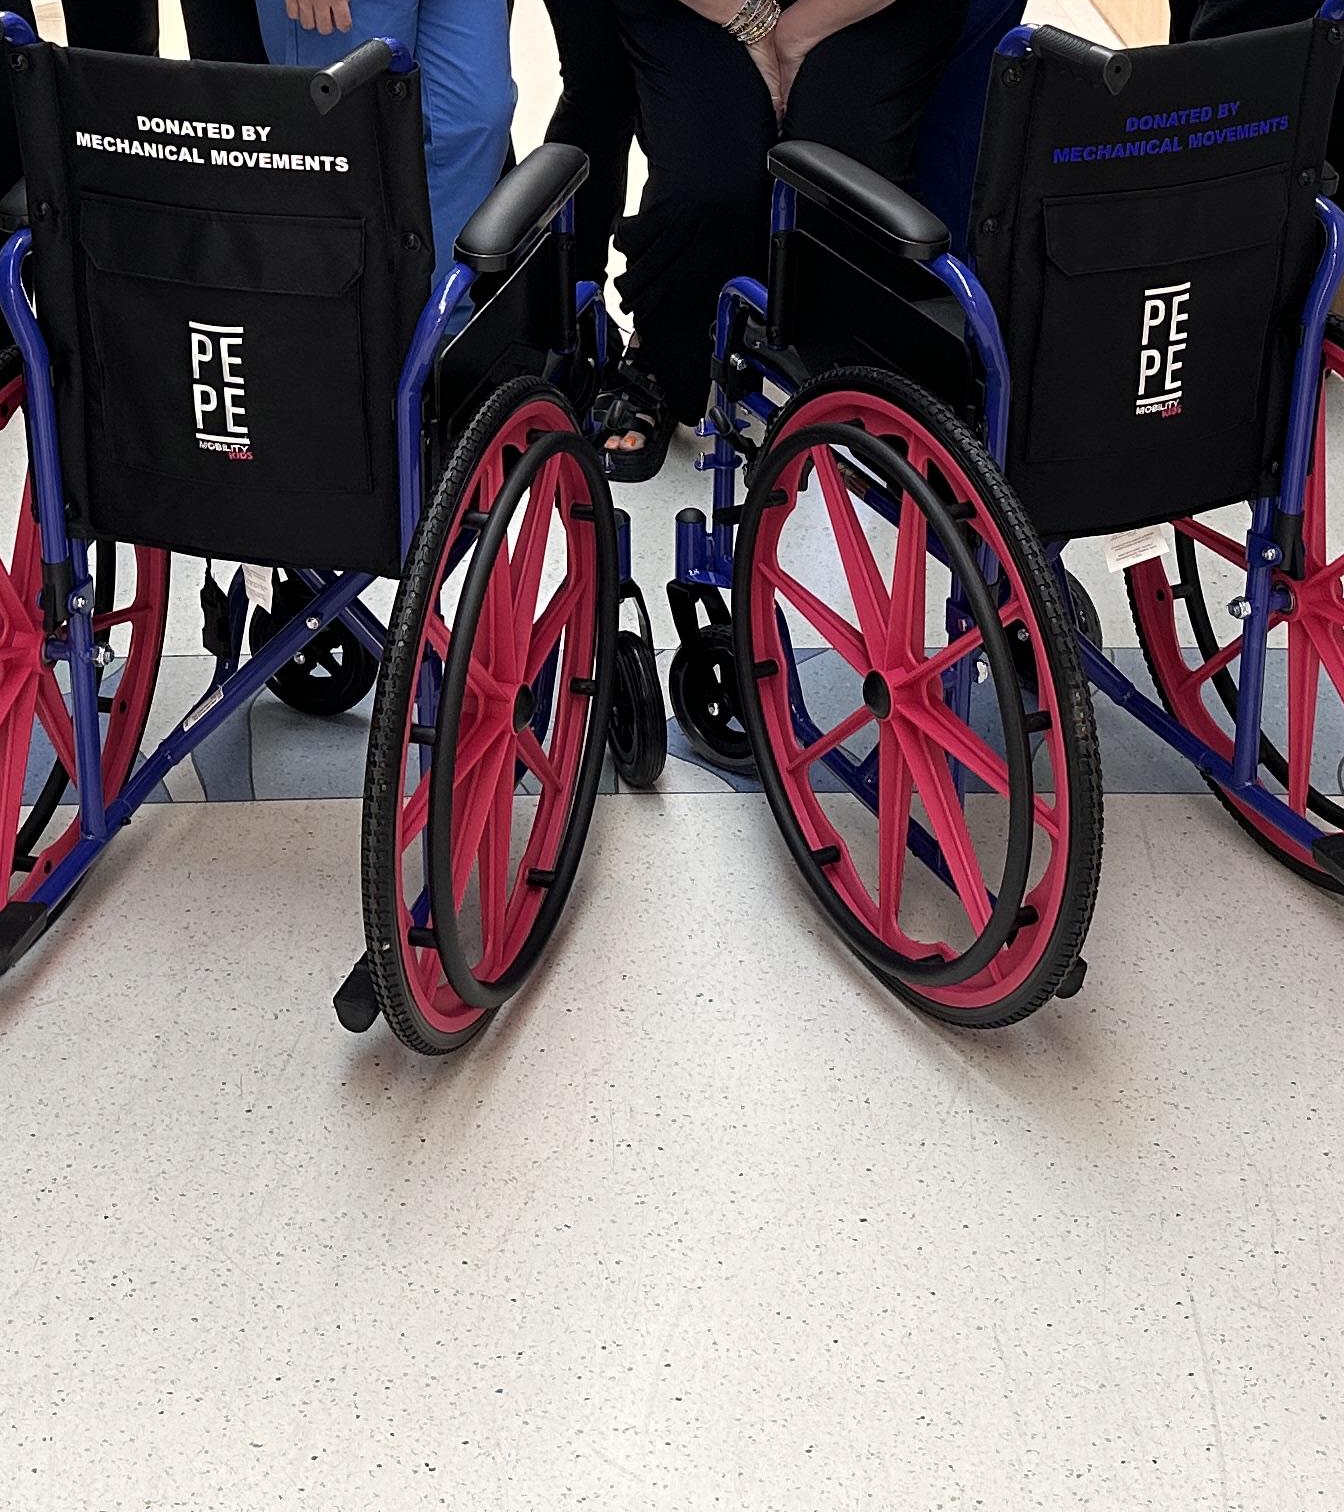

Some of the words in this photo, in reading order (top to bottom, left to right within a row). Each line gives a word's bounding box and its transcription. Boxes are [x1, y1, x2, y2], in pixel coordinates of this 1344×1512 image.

[136, 115, 235, 140] DONATED
[241, 126, 272, 142] BY
[1125, 106, 1212, 133] DONATED
[1217, 101, 1241, 119] BY
[75, 131, 205, 164] MECHANICAL
[210, 149, 349, 172] MOVEMENTS
[1053, 137, 1182, 164] MECHANICAL
[1188, 115, 1289, 149] MOVEMENTS
[1141, 292, 1190, 346] PE
[191, 332, 245, 385] PE
[1138, 343, 1186, 396] PE
[193, 384, 249, 434] PE
[1136, 399, 1179, 415] MOBILITY
[199, 440, 249, 453] MOBILITY
[228, 451, 254, 460] KIDS
